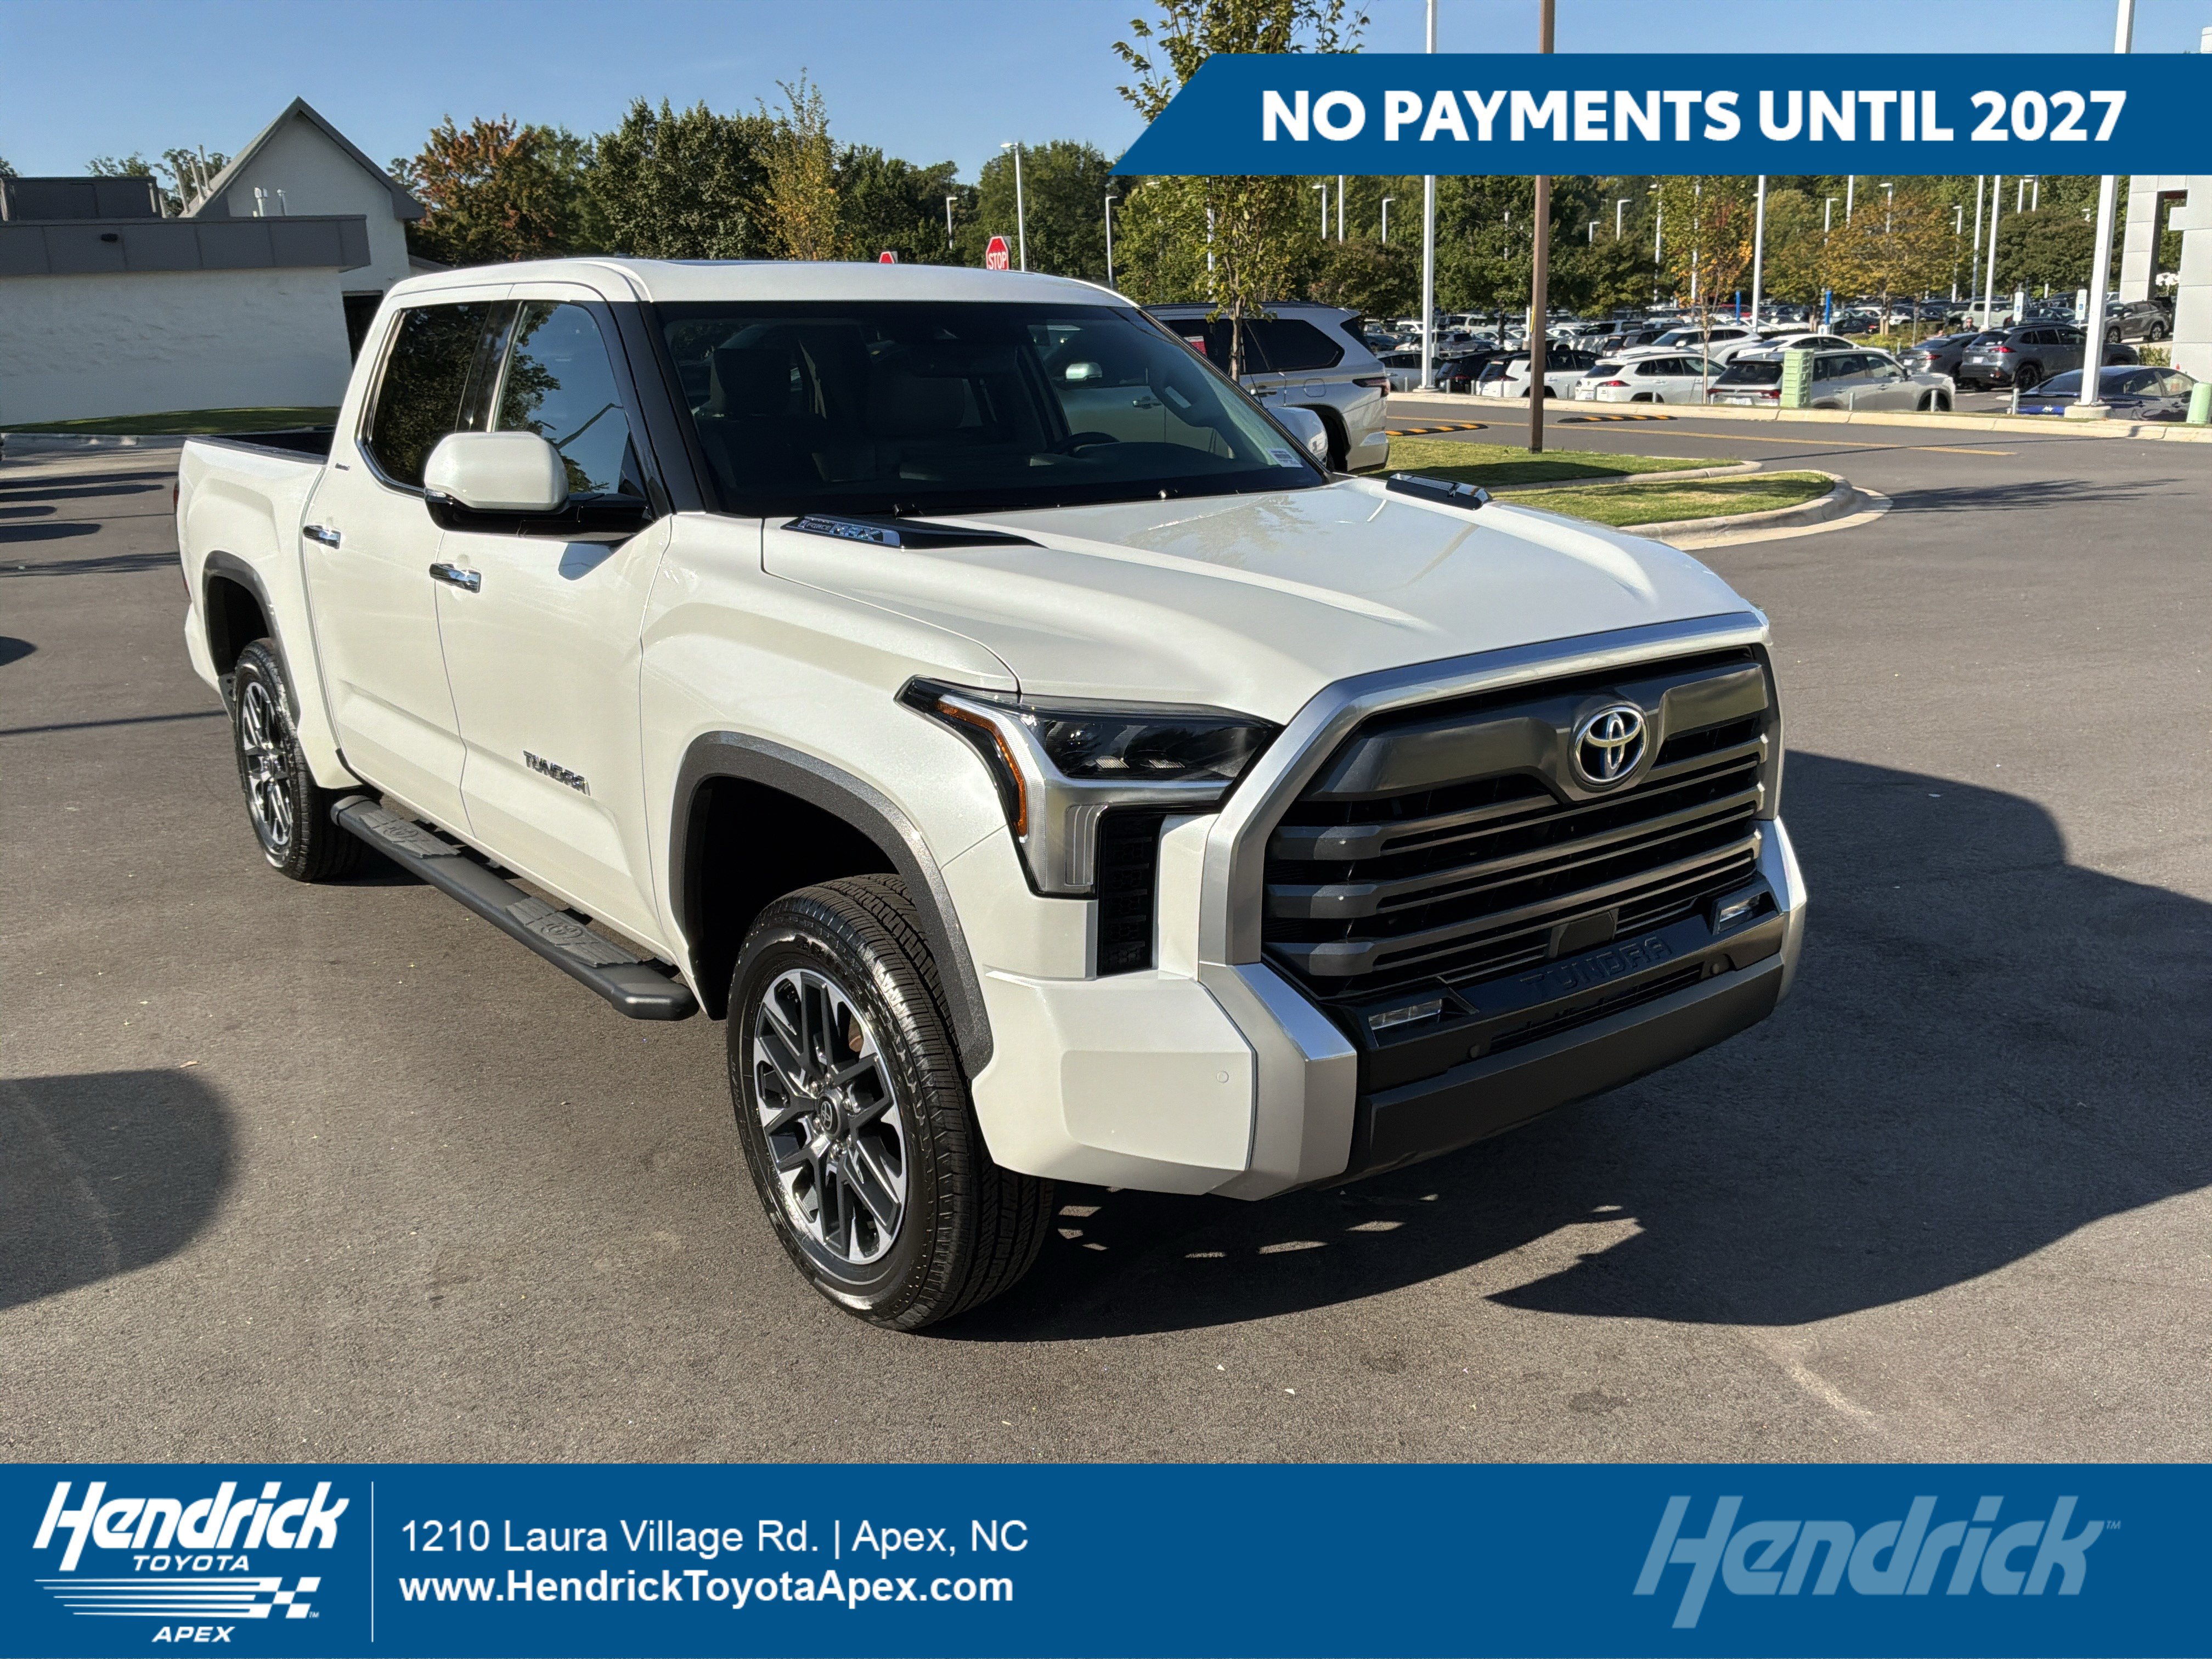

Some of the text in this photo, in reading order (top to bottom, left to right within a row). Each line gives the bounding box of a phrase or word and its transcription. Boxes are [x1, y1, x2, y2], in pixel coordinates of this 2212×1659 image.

[988, 251, 1007, 270] STOP
[523, 750, 591, 796] TUNDRA
[1520, 936, 1673, 994] TUNDRA
